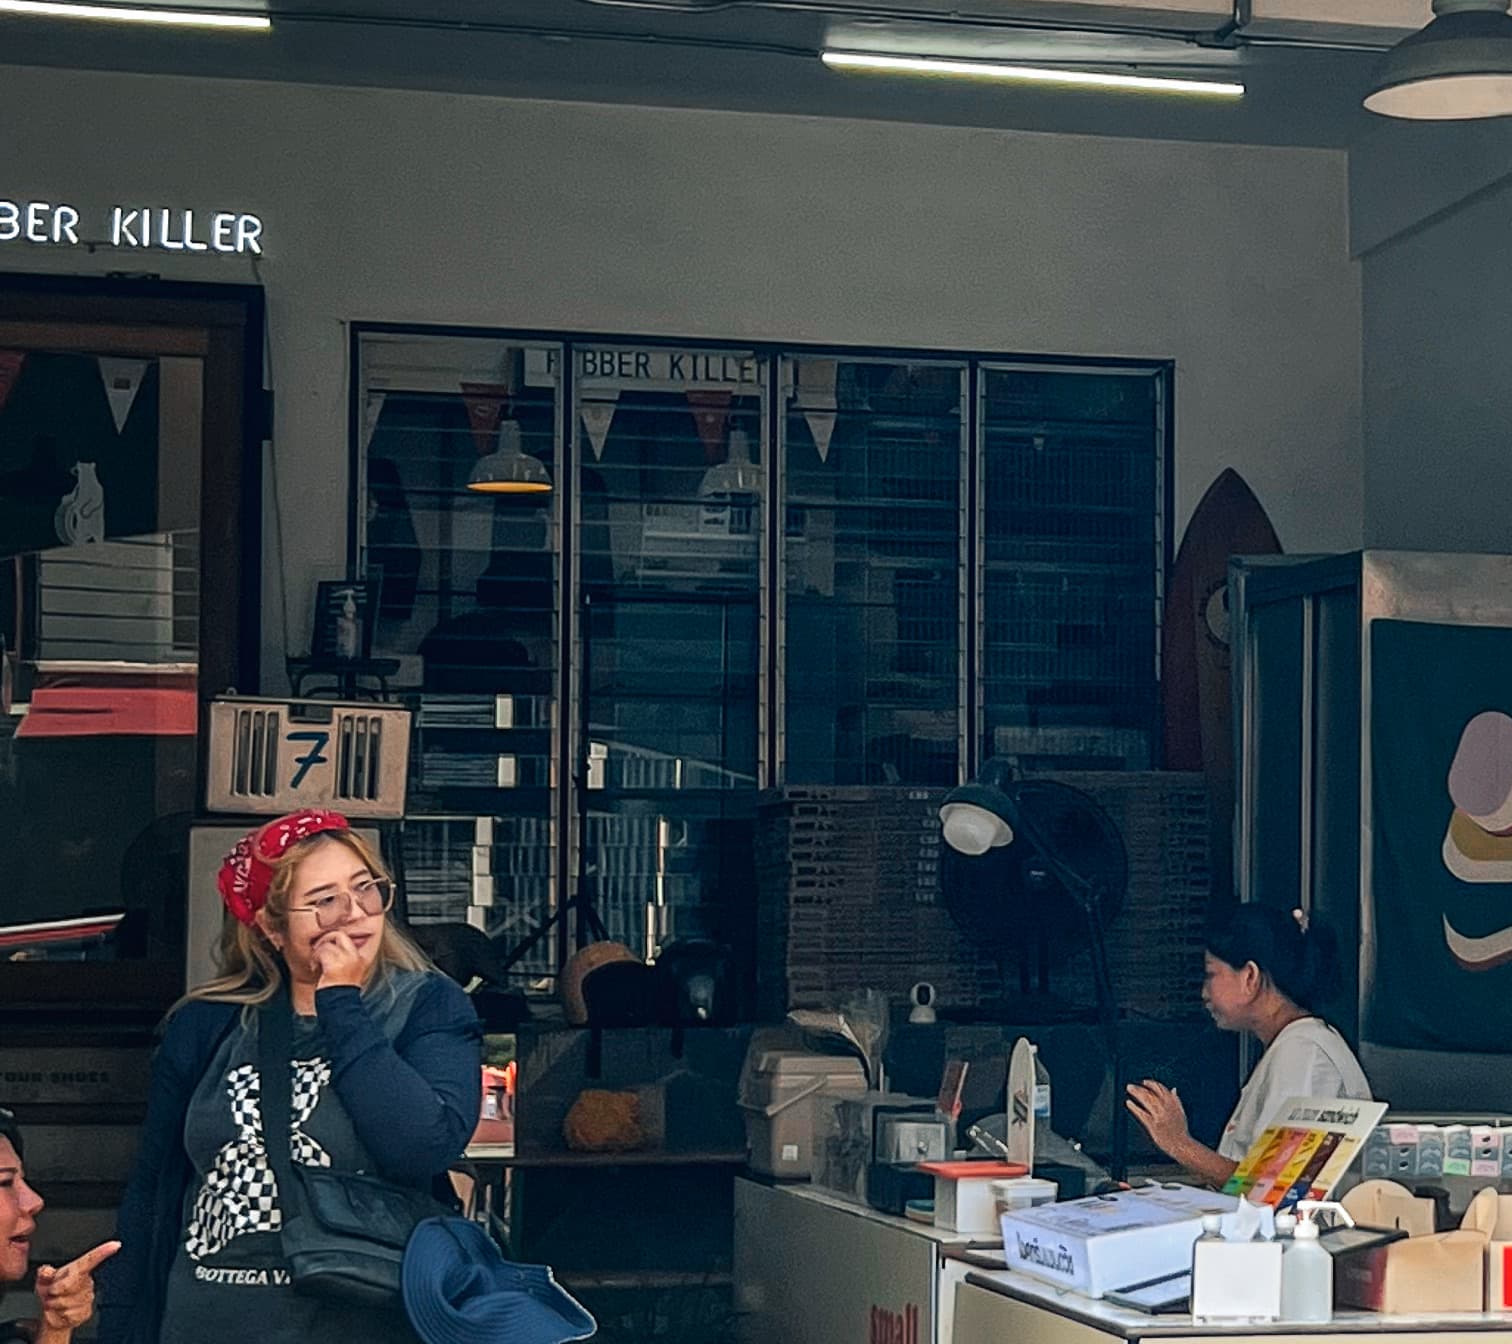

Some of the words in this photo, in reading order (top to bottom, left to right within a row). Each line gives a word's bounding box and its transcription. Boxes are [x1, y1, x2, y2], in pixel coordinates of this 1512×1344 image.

[111, 207, 263, 254] KILLER
[668, 355, 761, 384] KILLE
[286, 731, 329, 789] 7
[195, 1265, 268, 1285] BOTTEGA
